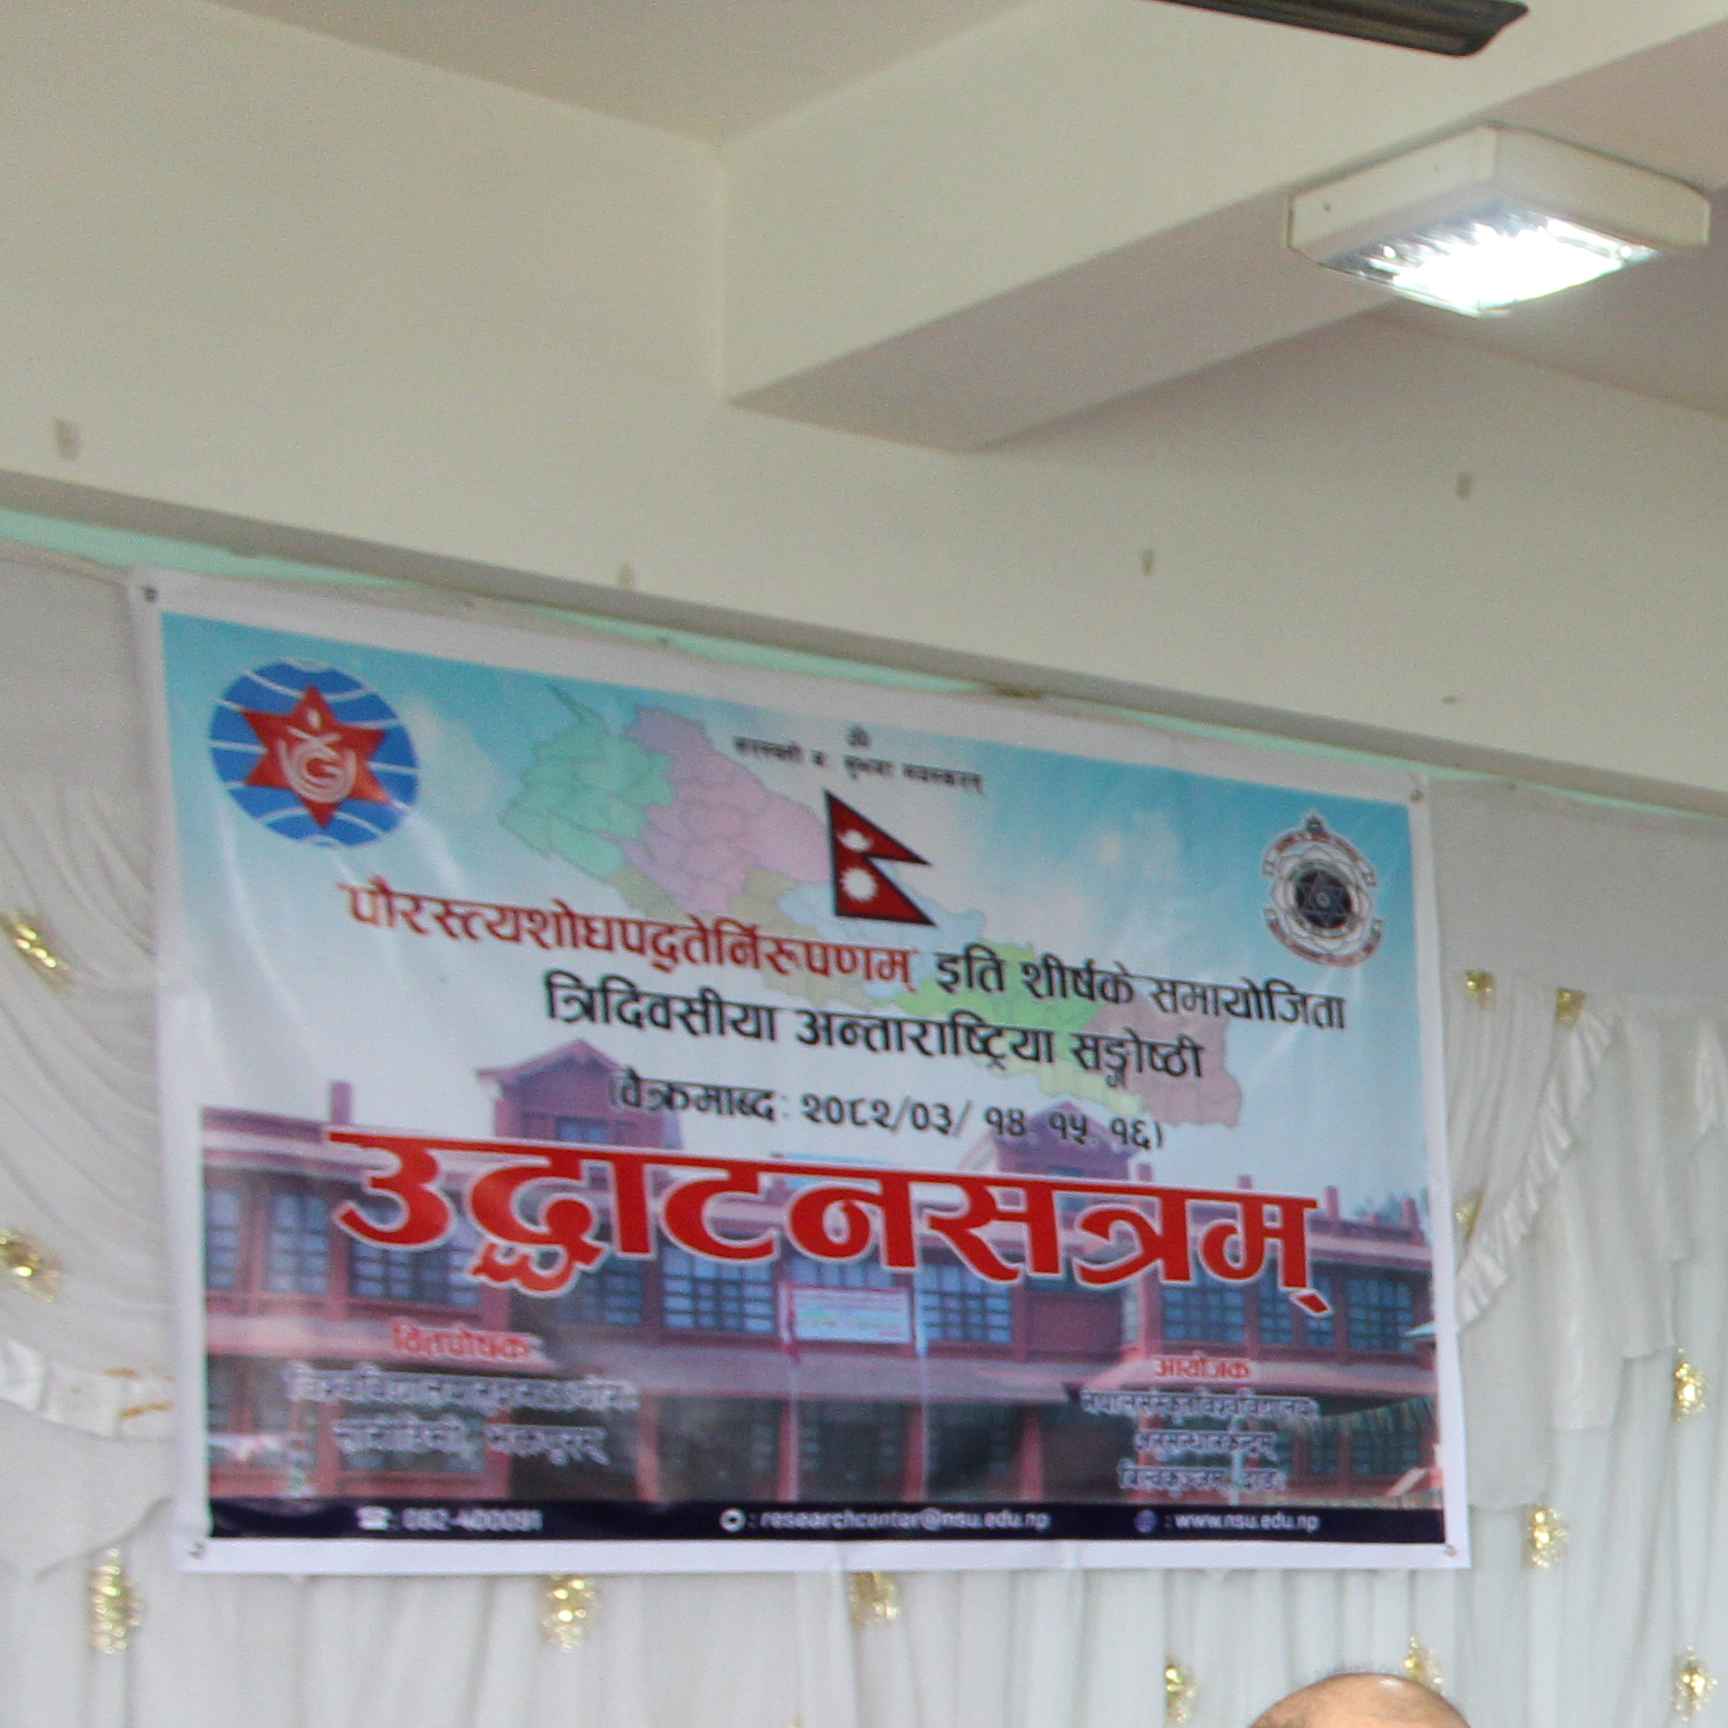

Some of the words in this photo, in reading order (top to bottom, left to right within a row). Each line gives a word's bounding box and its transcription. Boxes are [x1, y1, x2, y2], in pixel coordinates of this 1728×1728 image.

[543, 967, 778, 1043] त्रिदिवसीया
[934, 943, 1006, 993] इति
[1021, 952, 1136, 1006] शीर्षके
[1149, 975, 1347, 1030] समायोजिता
[327, 1128, 1332, 1318] उद्घाटनसत्रम्
[1174, 1512, 1320, 1533] www.nsu.edu.np
